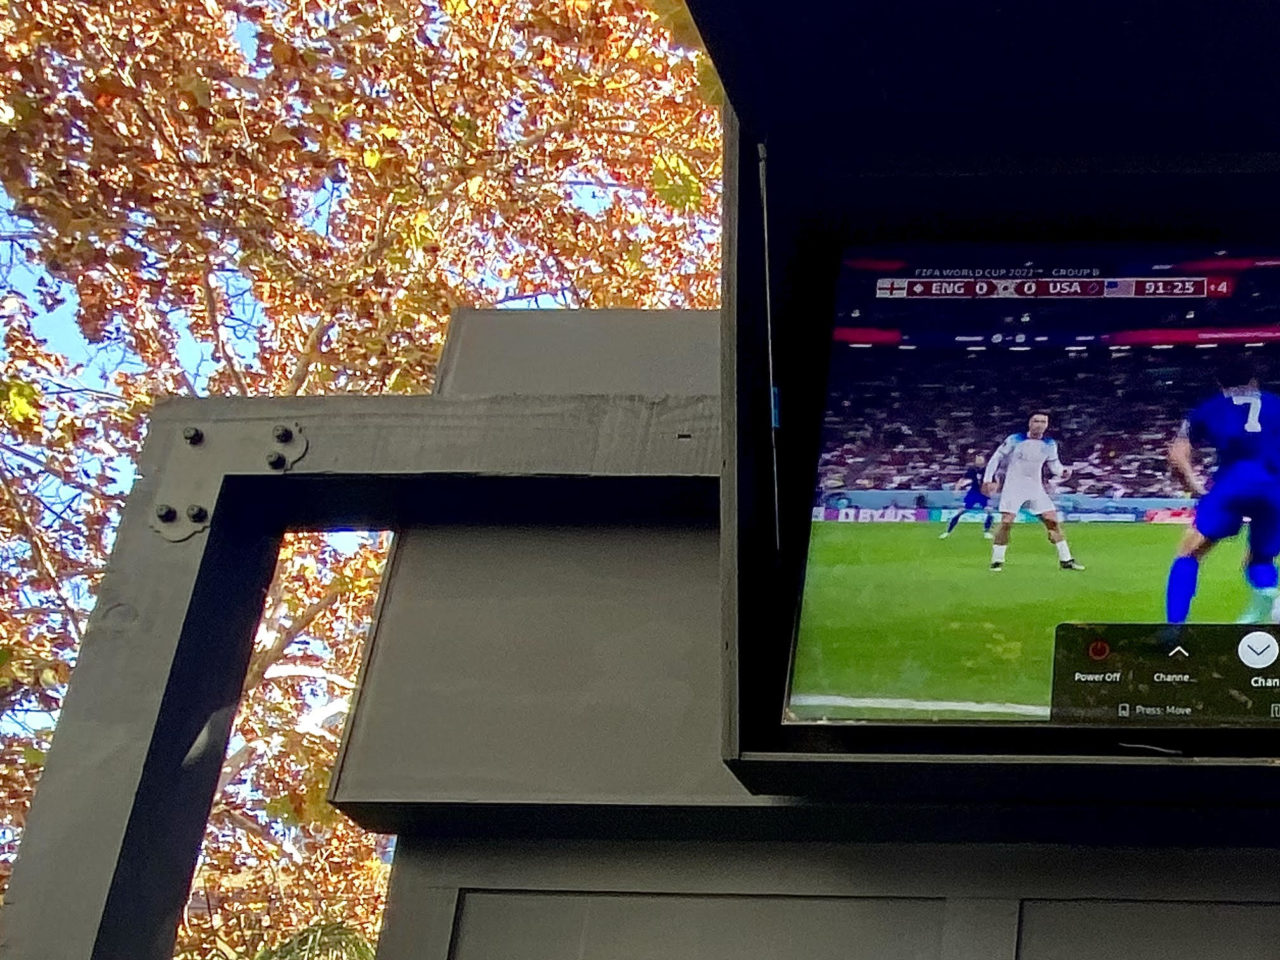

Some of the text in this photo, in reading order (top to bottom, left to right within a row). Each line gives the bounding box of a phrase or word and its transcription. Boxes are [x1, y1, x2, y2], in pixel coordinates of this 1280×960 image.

[915, 268, 940, 277] FIFA
[942, 268, 983, 277] WORLD
[985, 268, 1006, 277] CUP
[1052, 268, 1090, 277] GROUP
[931, 282, 965, 294] ENG
[975, 282, 988, 294] 0
[1023, 282, 1036, 294] 0
[1049, 282, 1081, 294] USA
[1145, 282, 1195, 294] 91:25
[1232, 396, 1262, 432] 7
[1074, 672, 1121, 682] Power Off
[1166, 706, 1192, 715] Move
